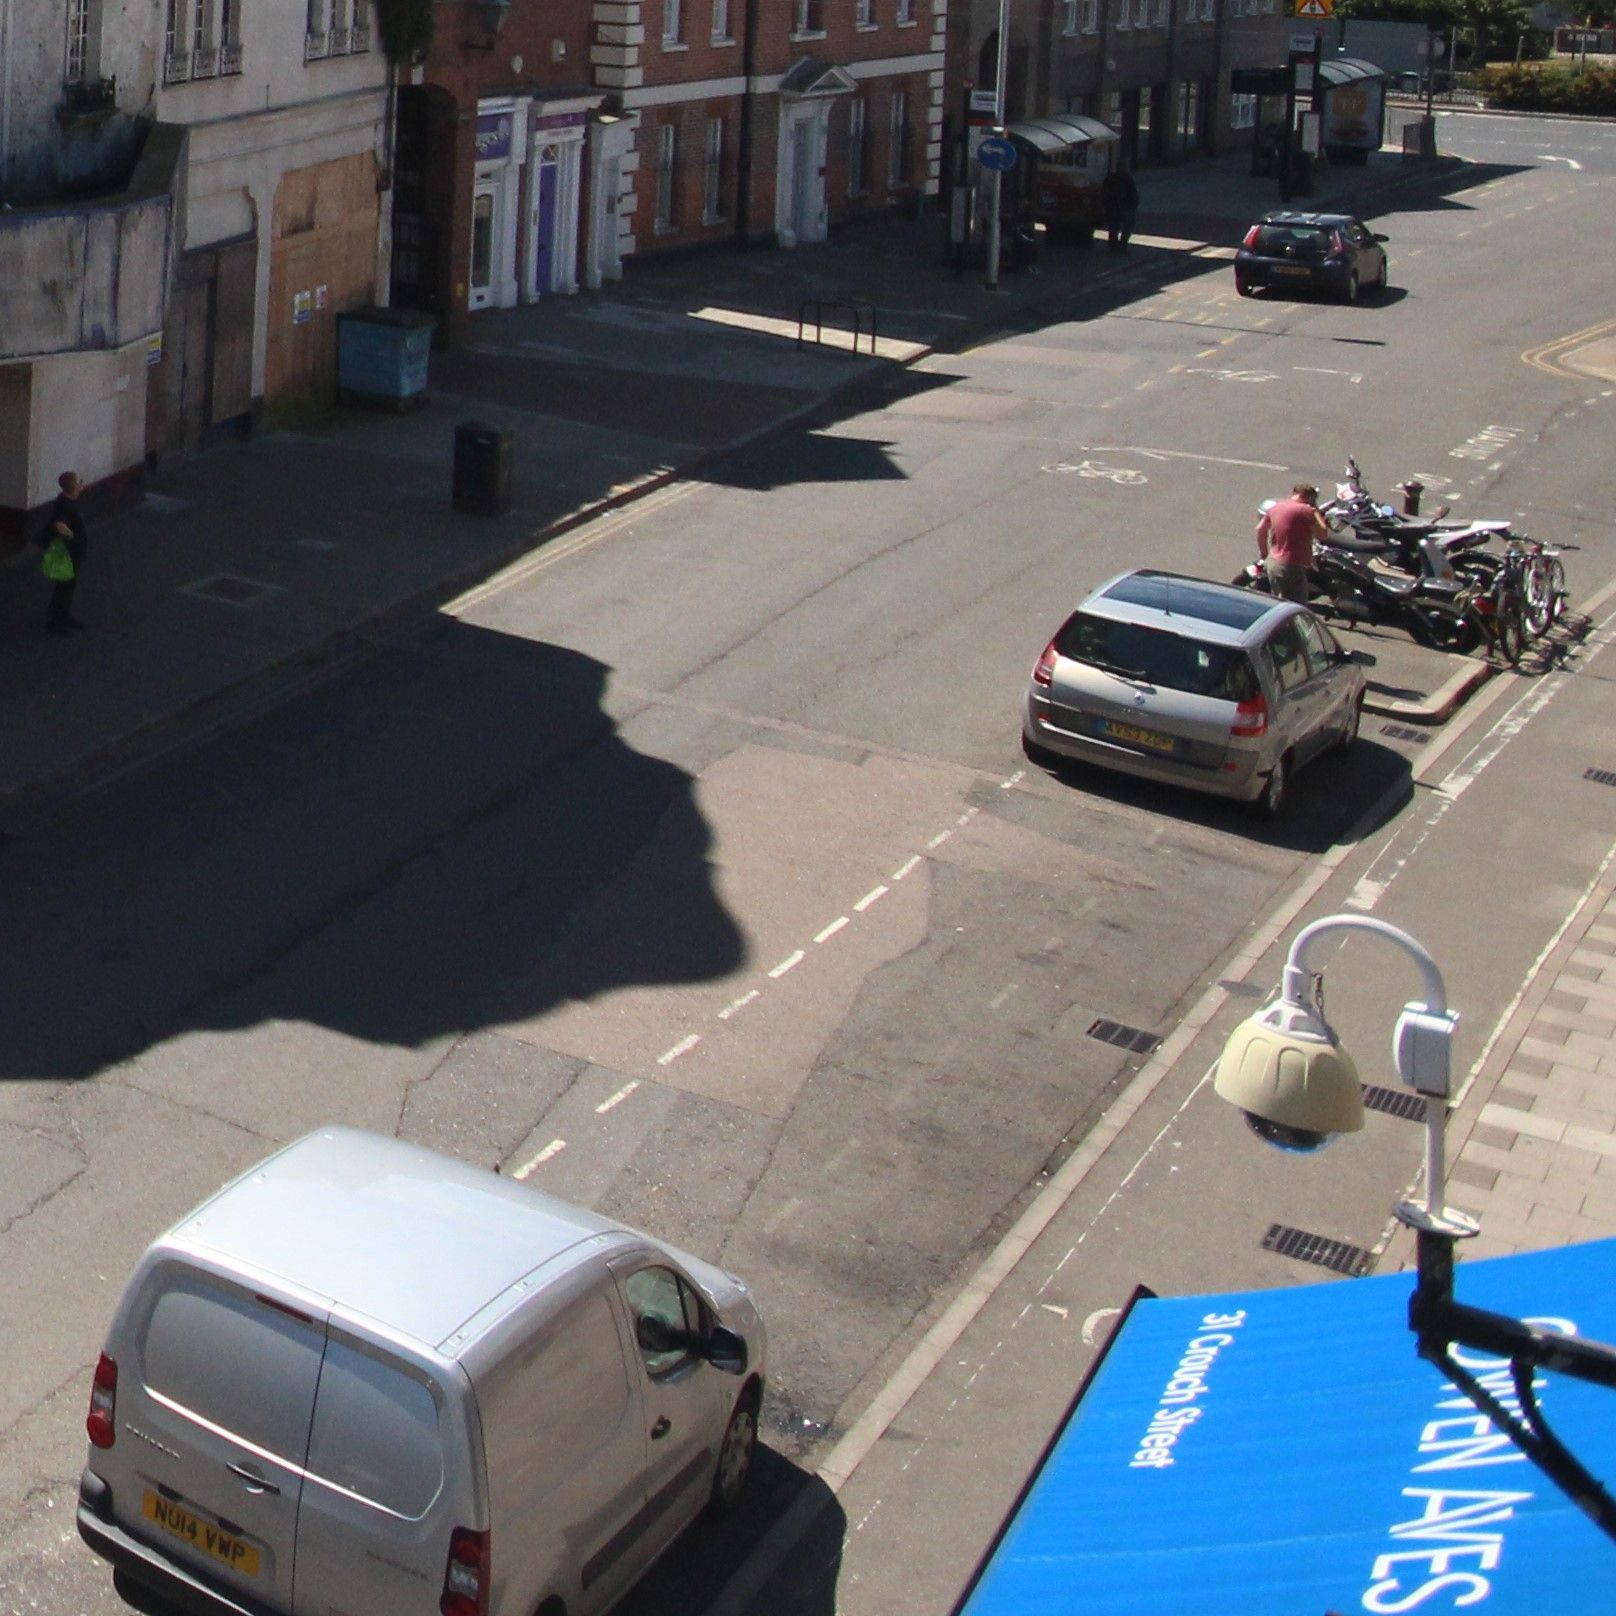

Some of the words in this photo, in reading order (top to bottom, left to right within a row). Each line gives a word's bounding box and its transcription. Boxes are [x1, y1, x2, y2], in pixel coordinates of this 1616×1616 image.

[1198, 1309, 1248, 1332] 31
[1159, 1333, 1235, 1405] Crouch
[1128, 1406, 1204, 1469] Street
[154, 1498, 198, 1541] NU14
[1360, 1486, 1535, 1615] AVES
